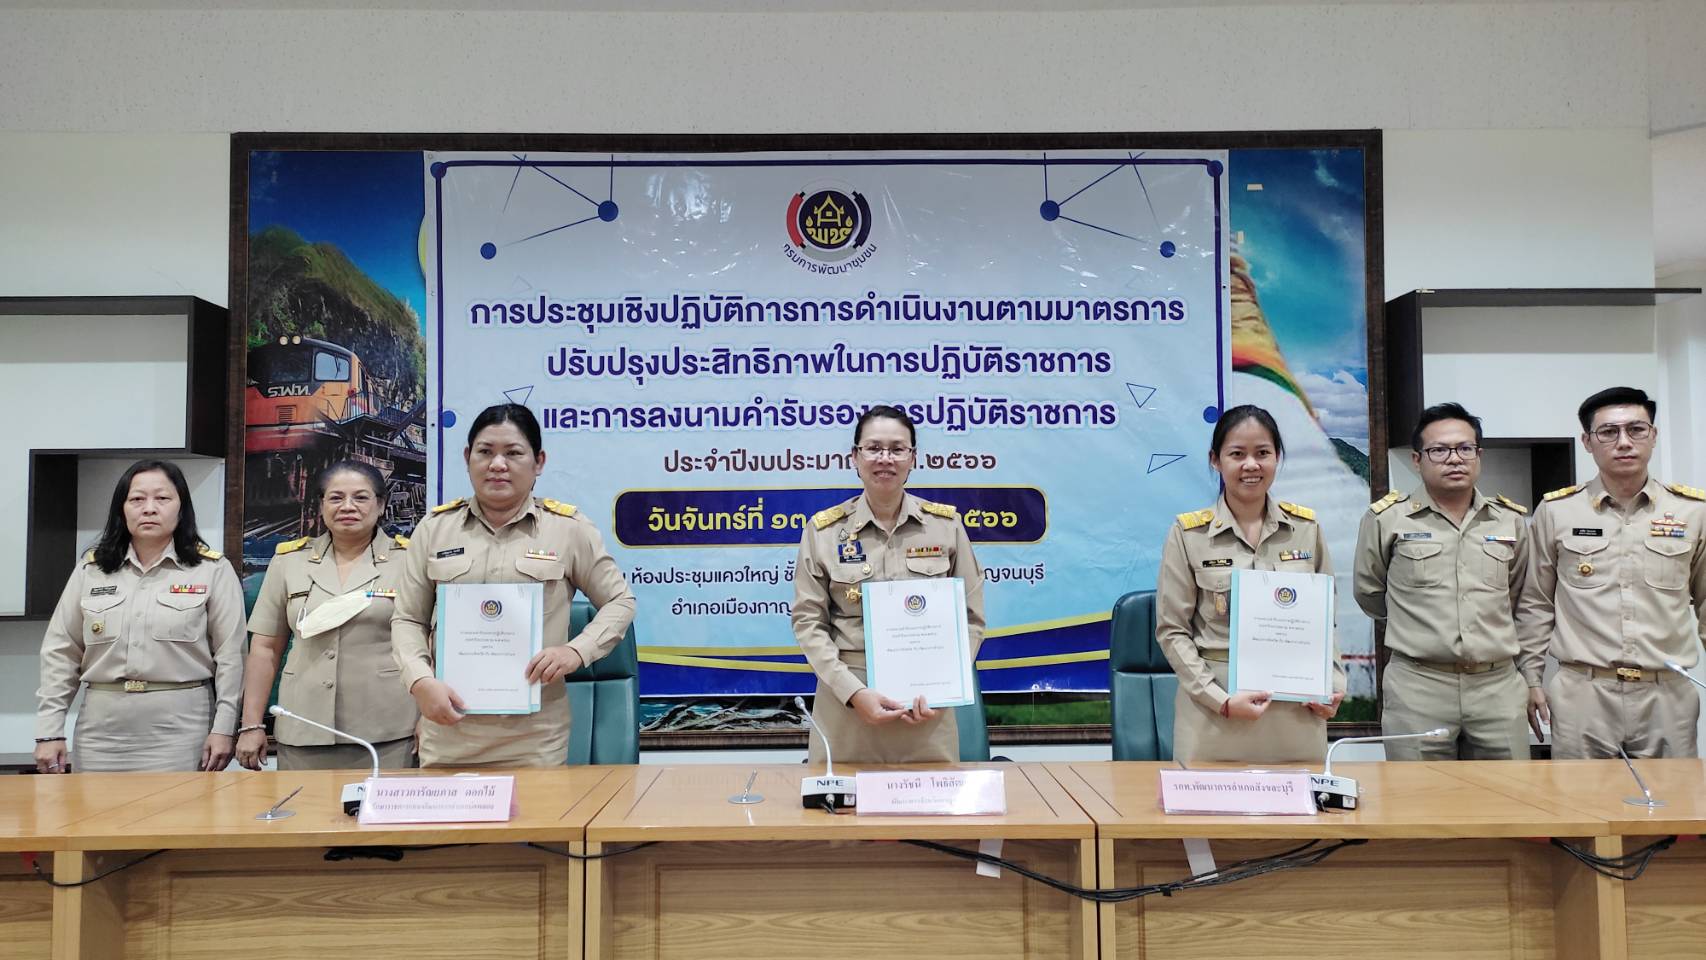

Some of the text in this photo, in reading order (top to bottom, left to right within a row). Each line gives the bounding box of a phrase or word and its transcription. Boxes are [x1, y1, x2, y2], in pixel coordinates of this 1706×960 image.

[783, 243, 878, 275] กรมการพัฒนาชุมชน
[470, 291, 1185, 334] การประชุมเชิงปฏิบัติการการดำเนินงานตามมาตรการ
[547, 343, 1112, 386] ปรับปรุงประสิทธิภาพในการปฏิบัติราชการ
[543, 396, 1117, 432] และการลงนามคำรับรองรปฏิบัติราชการ
[913, 452, 997, 470] .๒๕๖๖
[648, 497, 764, 531] วันจันทร์ที่
[957, 509, 1018, 528] ๕๖๖
[630, 565, 779, 588] ห้องประชุมแควใหญ่
[984, 563, 1045, 585] ญจนบุรี
[671, 598, 793, 617] อำเภอเมืองกาญ
[816, 779, 845, 787] NPE
[1311, 776, 1340, 788] NPE
